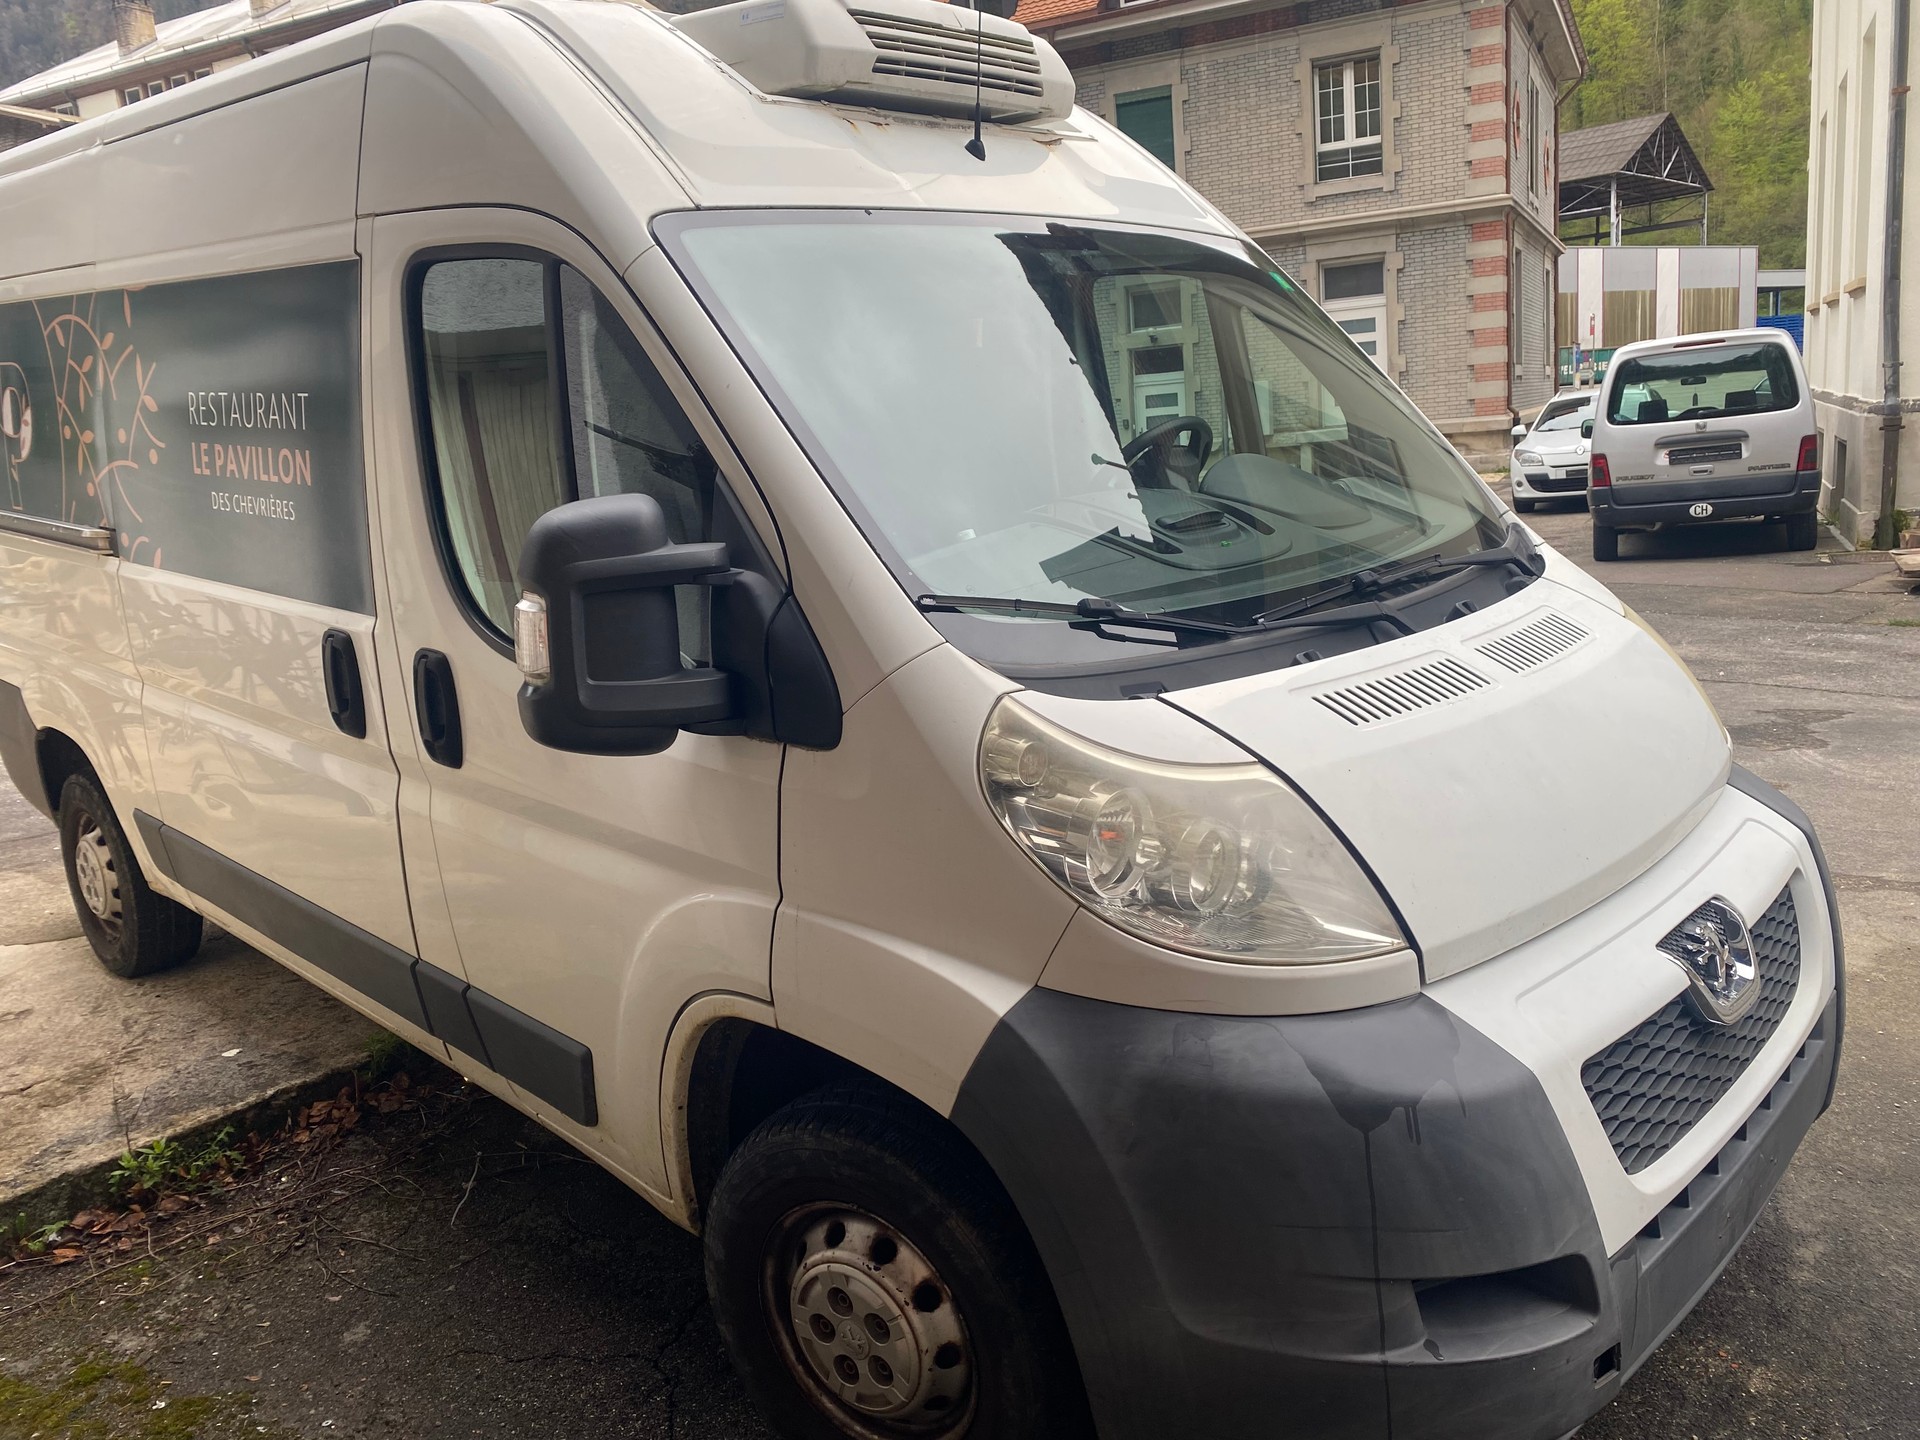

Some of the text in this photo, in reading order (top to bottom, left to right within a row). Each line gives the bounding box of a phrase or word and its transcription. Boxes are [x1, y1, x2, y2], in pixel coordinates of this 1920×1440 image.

[188, 391, 308, 430] RESTAURANT
[191, 442, 311, 486] LE PAVILLON
[211, 491, 295, 520] DES CHEVRIÈRES
[1693, 504, 1708, 516] CH
